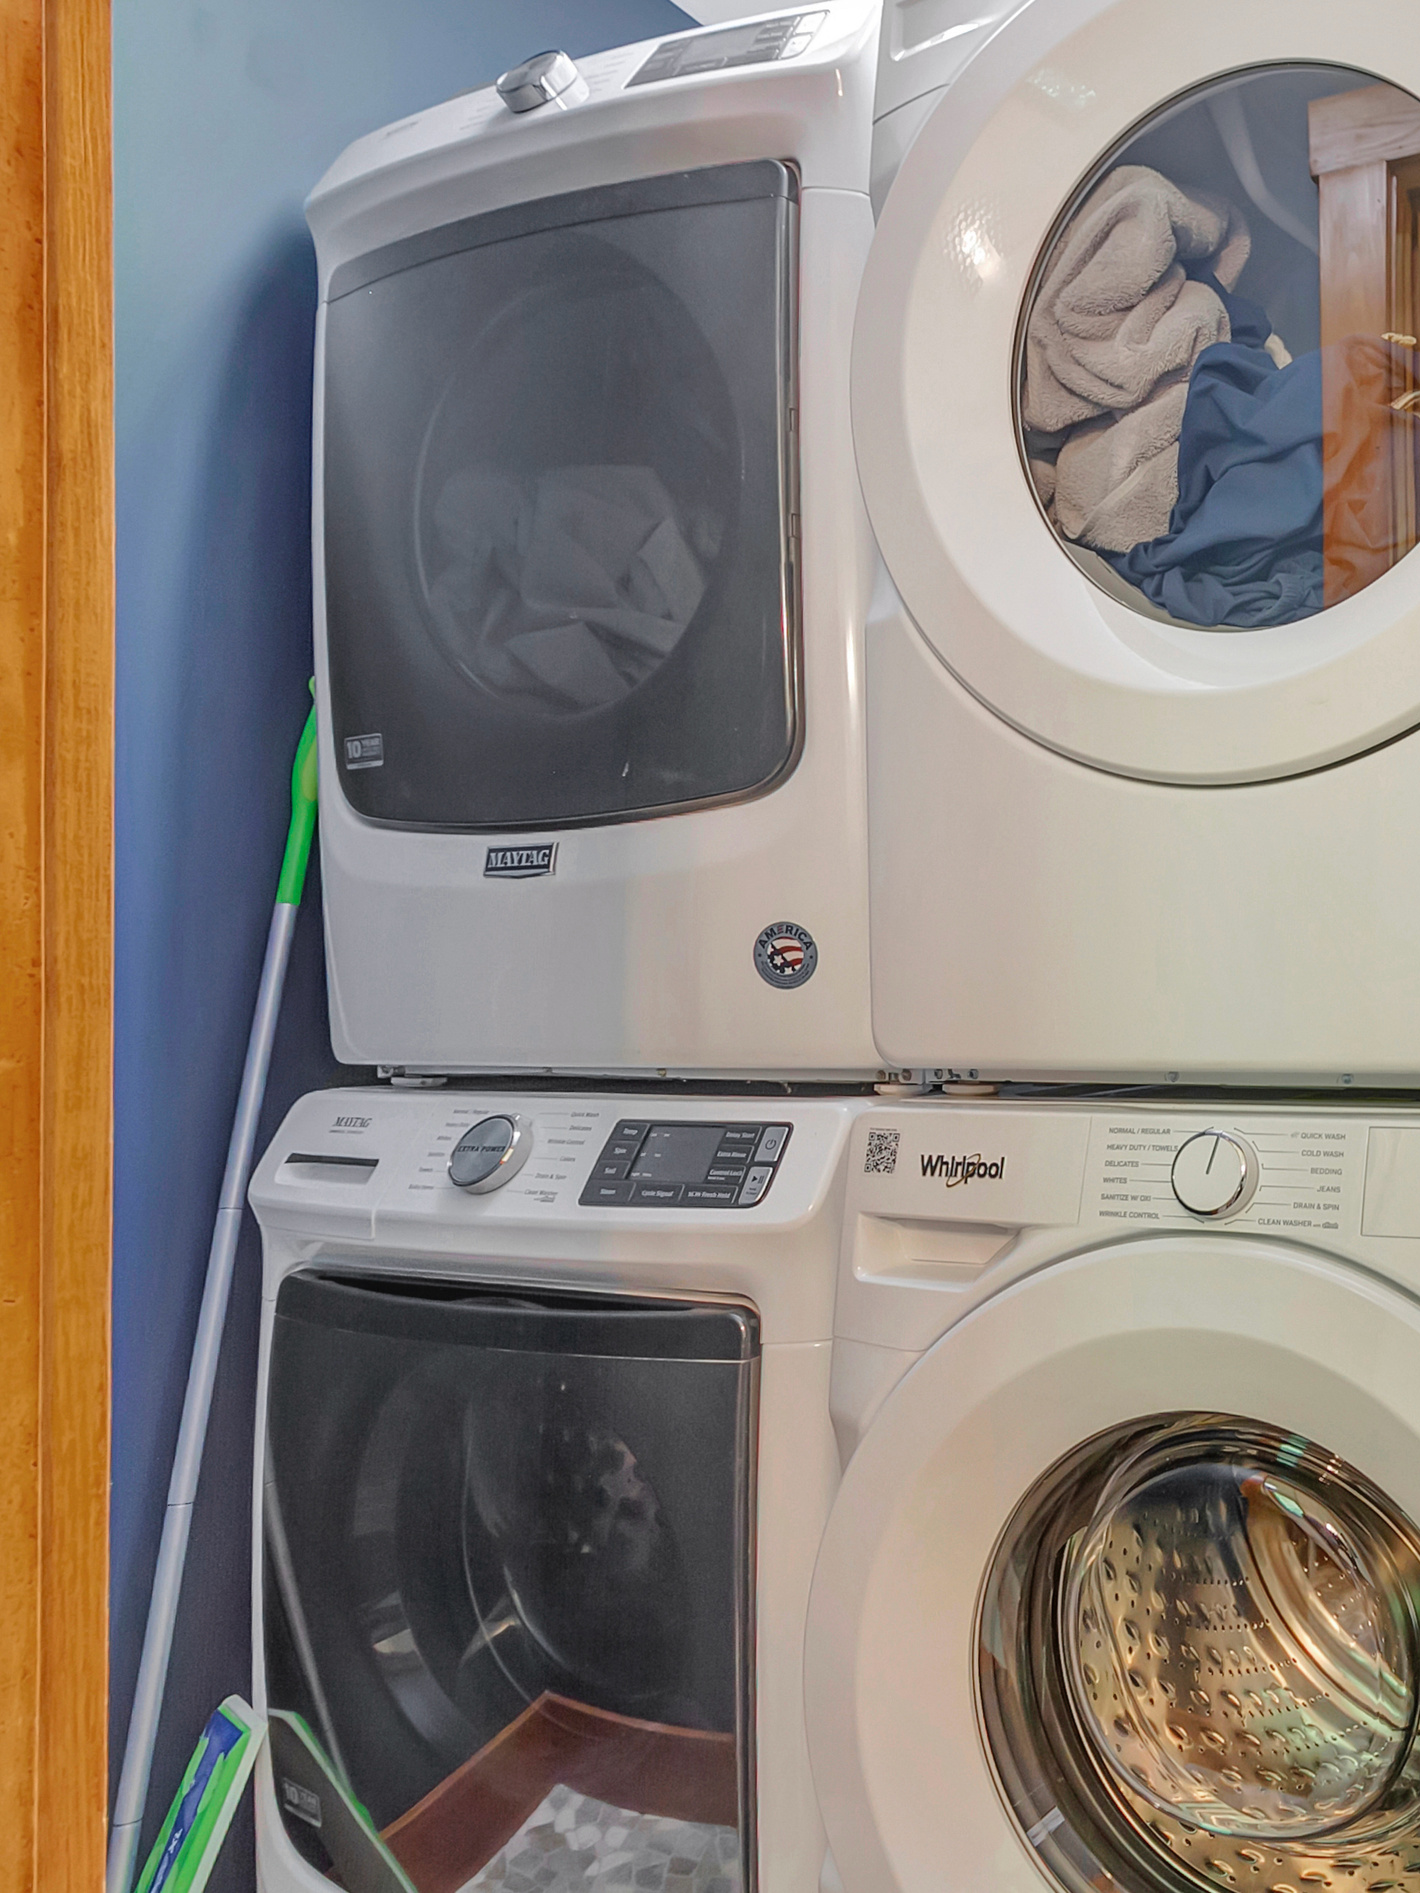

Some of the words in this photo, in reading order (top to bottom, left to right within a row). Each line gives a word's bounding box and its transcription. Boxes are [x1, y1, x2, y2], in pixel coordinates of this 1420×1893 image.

[347, 740, 361, 759] 10
[487, 850, 550, 868] MAYTAG
[758, 925, 813, 950] AMERICA
[332, 1116, 373, 1128] MAYTAG
[1141, 1127, 1171, 1135] REGULAR
[1301, 1132, 1323, 1140] QUICK
[1152, 1144, 1179, 1152] TOWELS
[1301, 1149, 1322, 1157] COLD
[921, 1154, 1005, 1184] Whirlpool
[1310, 1167, 1343, 1175] BEDDING
[1102, 1176, 1128, 1184] WHITES
[1316, 1185, 1341, 1193] JEANS
[1100, 1193, 1129, 1201] SANITIZE
[1322, 1203, 1340, 1211] SPIN
[1099, 1210, 1128, 1218] WRINKLE
[1128, 1211, 1160, 1219] CONTROL
[1257, 1218, 1281, 1226] CLEAN
[1282, 1219, 1312, 1227] WASHER
